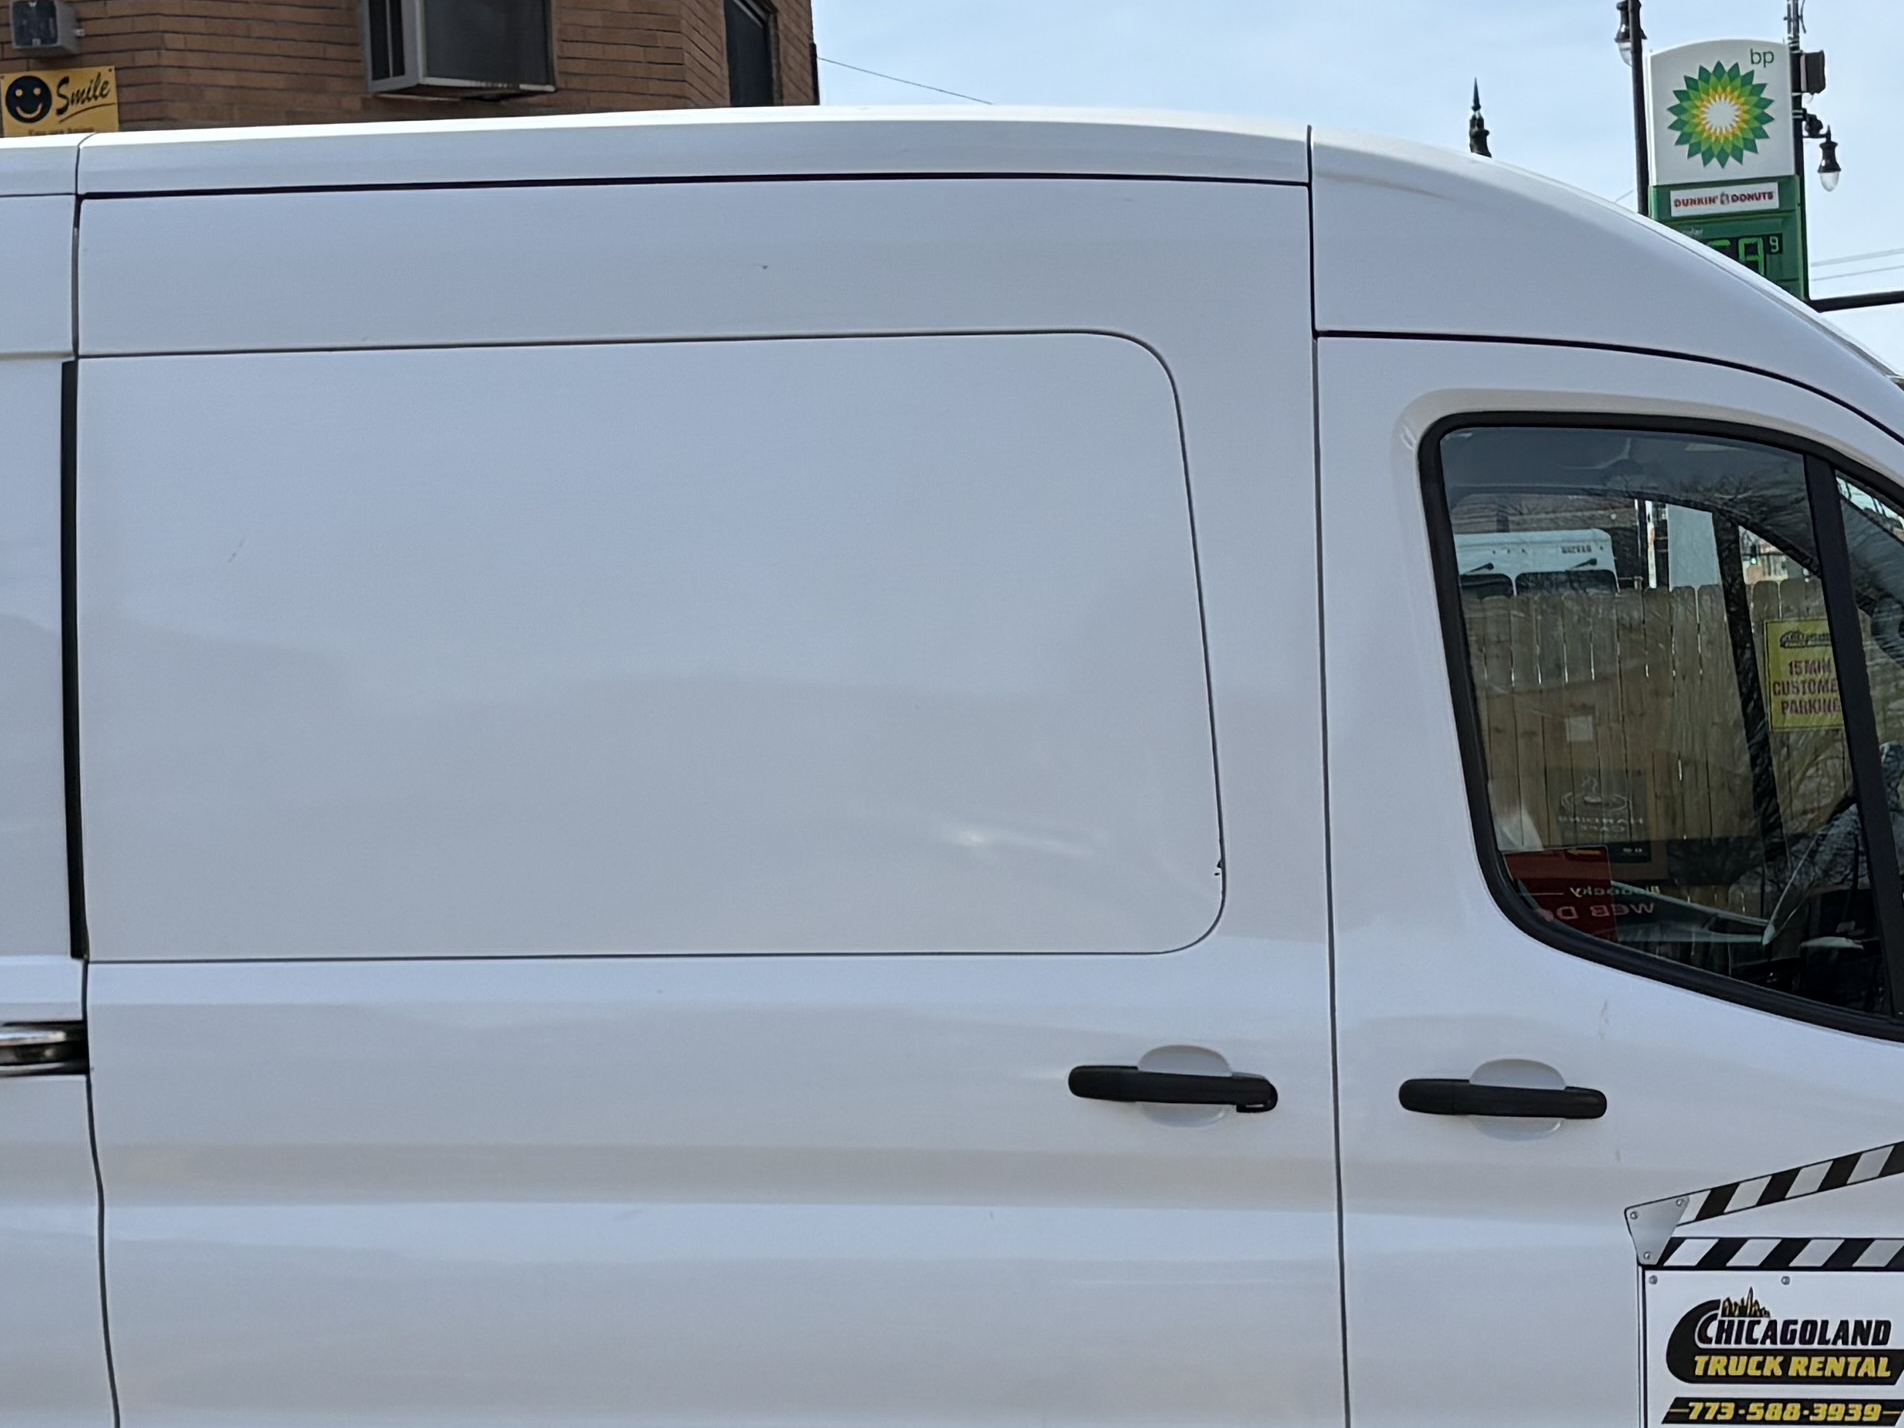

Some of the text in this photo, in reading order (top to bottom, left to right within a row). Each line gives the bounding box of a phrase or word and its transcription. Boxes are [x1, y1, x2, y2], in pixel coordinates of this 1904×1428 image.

[1750, 48, 1775, 68] bp
[56, 71, 111, 116] Smile
[1731, 191, 1774, 203] DONUTS
[1772, 678, 1838, 696] CUSTOME
[1696, 1312, 1892, 1347] CHICAGOLAND
[1694, 1355, 1892, 1378] TRUCK RENTAL
